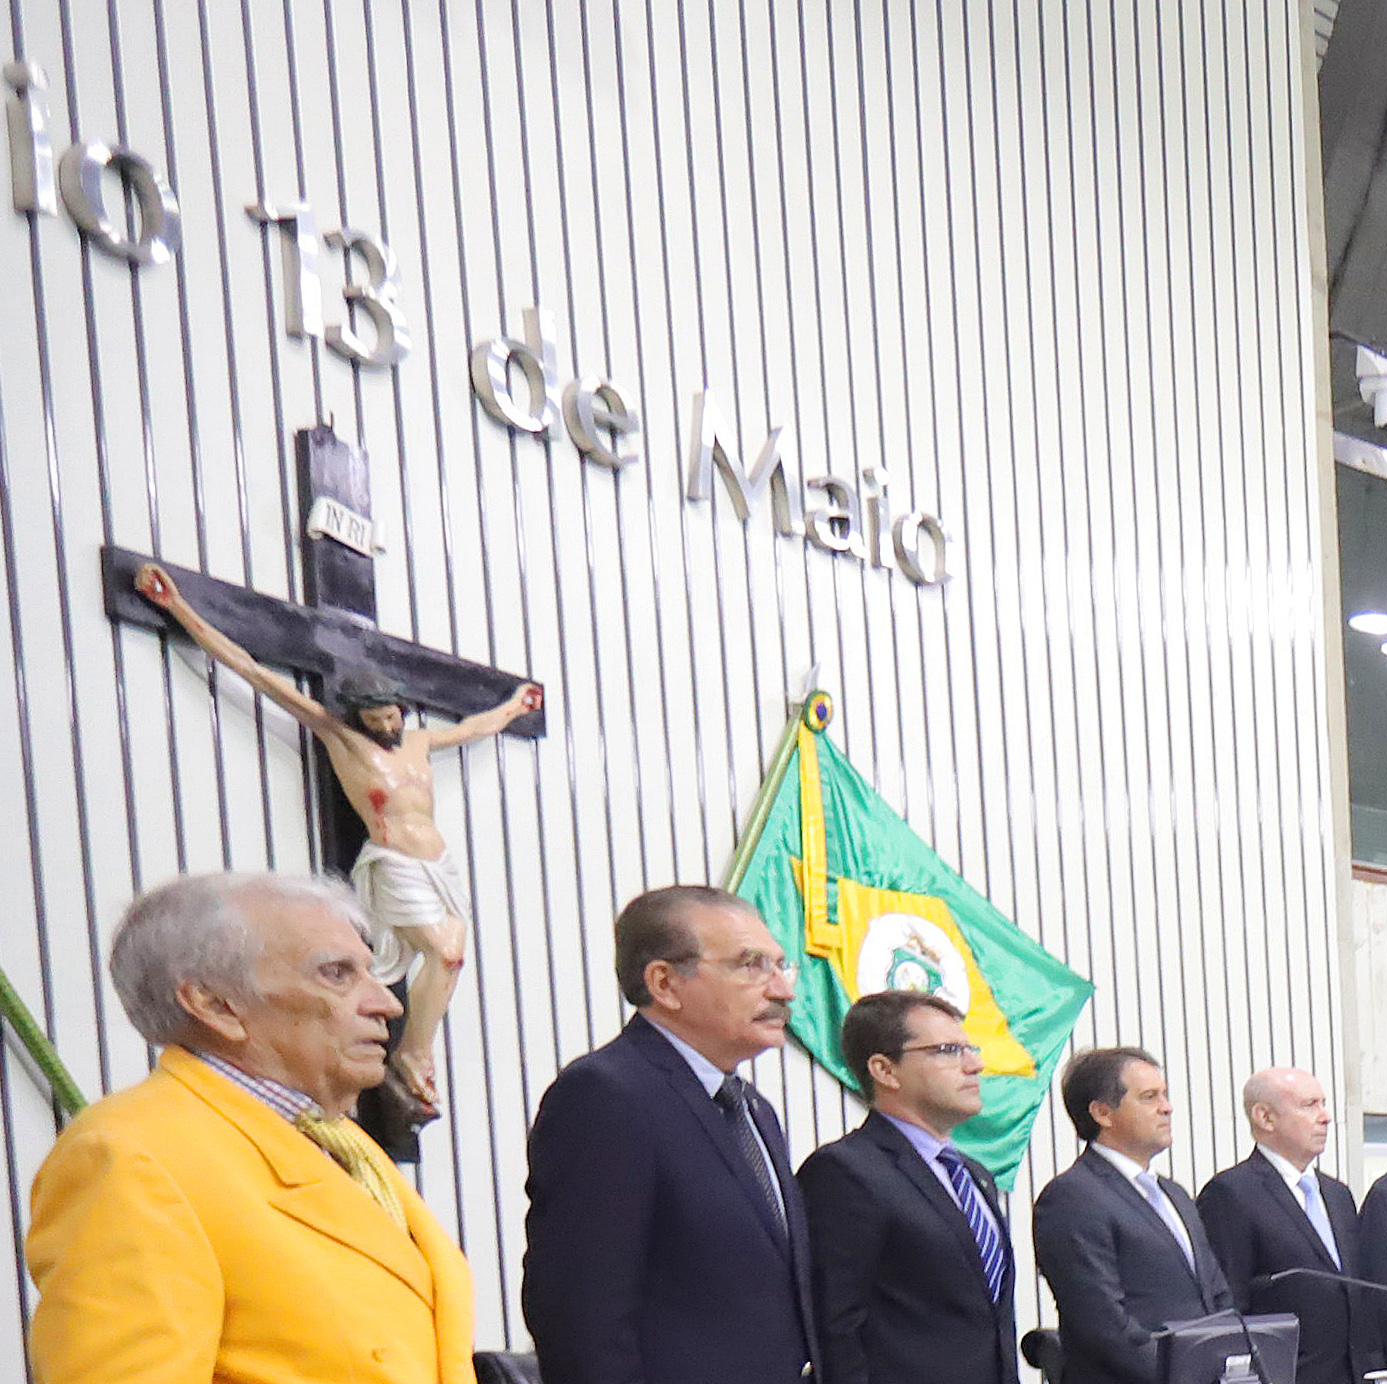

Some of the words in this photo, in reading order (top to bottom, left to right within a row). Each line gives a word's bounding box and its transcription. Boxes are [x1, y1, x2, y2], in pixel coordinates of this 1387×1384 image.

[245, 199, 412, 367] 13
[469, 305, 640, 471] de
[686, 387, 954, 587] Maio
